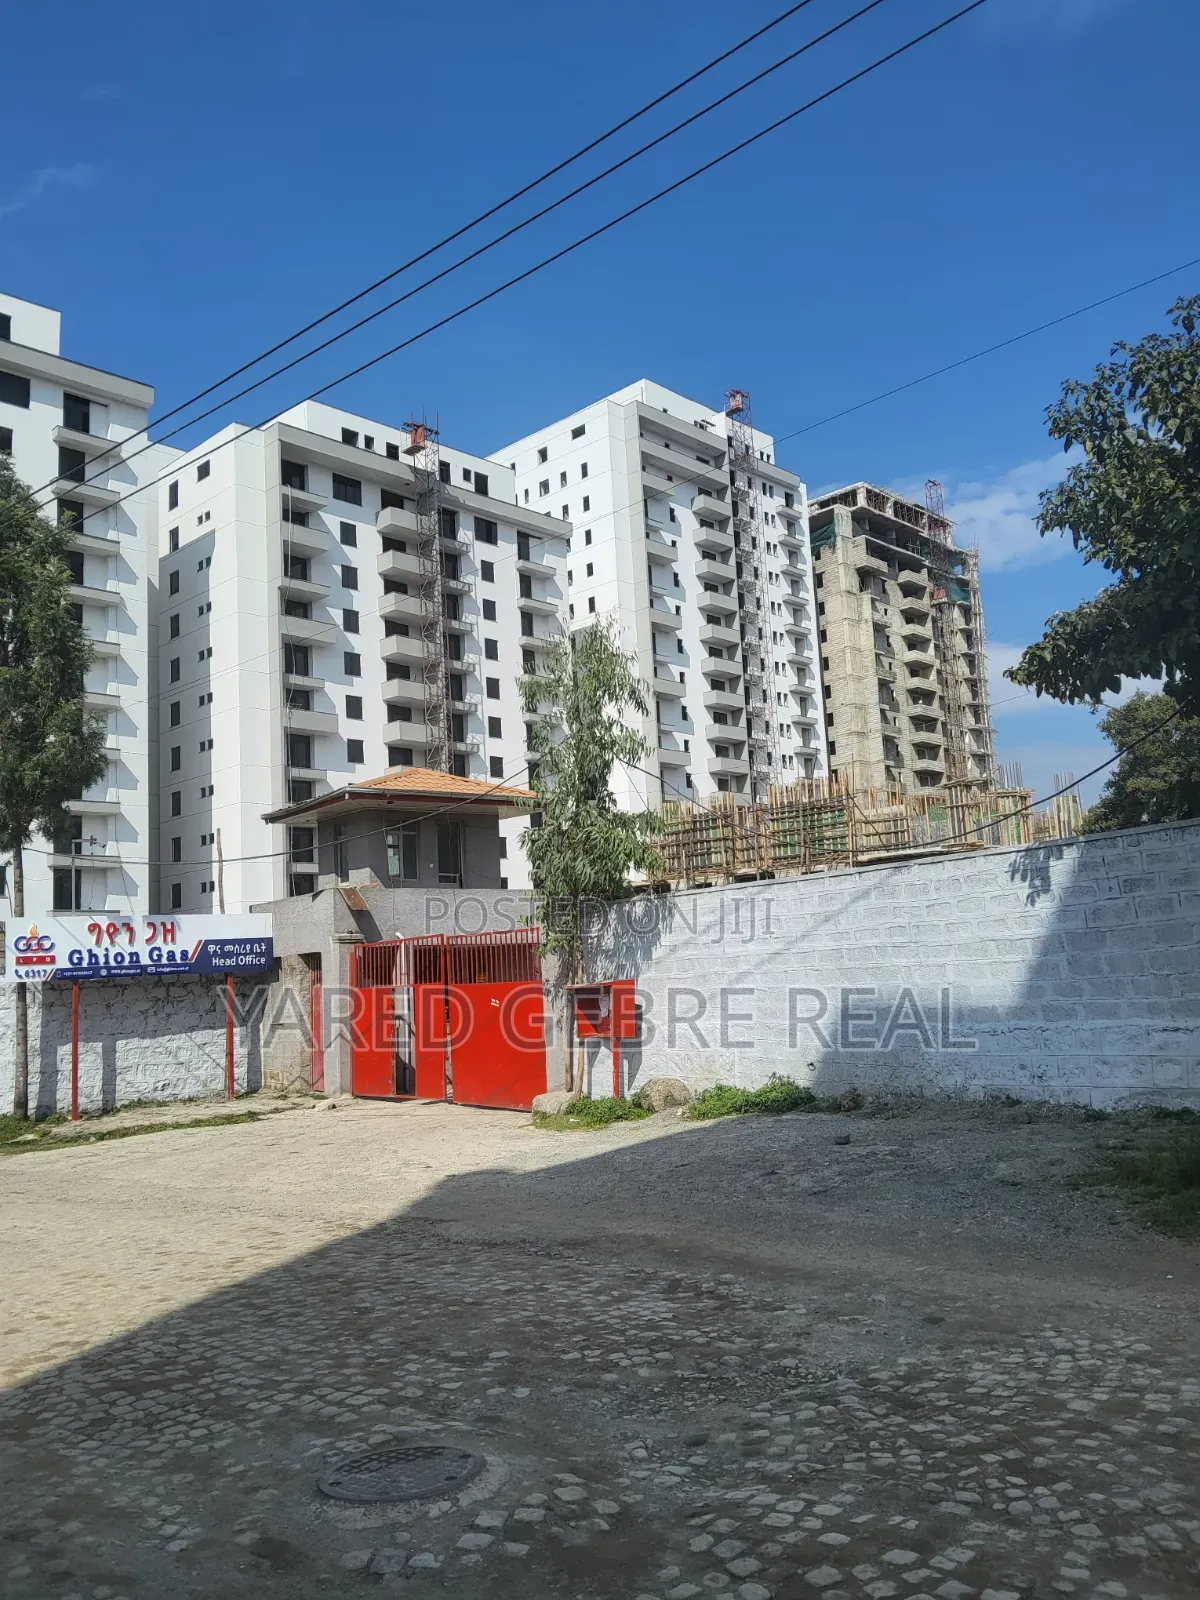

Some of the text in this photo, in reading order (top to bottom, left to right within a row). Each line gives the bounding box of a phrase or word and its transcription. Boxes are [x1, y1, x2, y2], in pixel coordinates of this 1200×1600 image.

[253, 942, 267, 953] ቤት
[68, 946, 189, 966] Ghion Gas
[212, 954, 266, 966] Head Office
